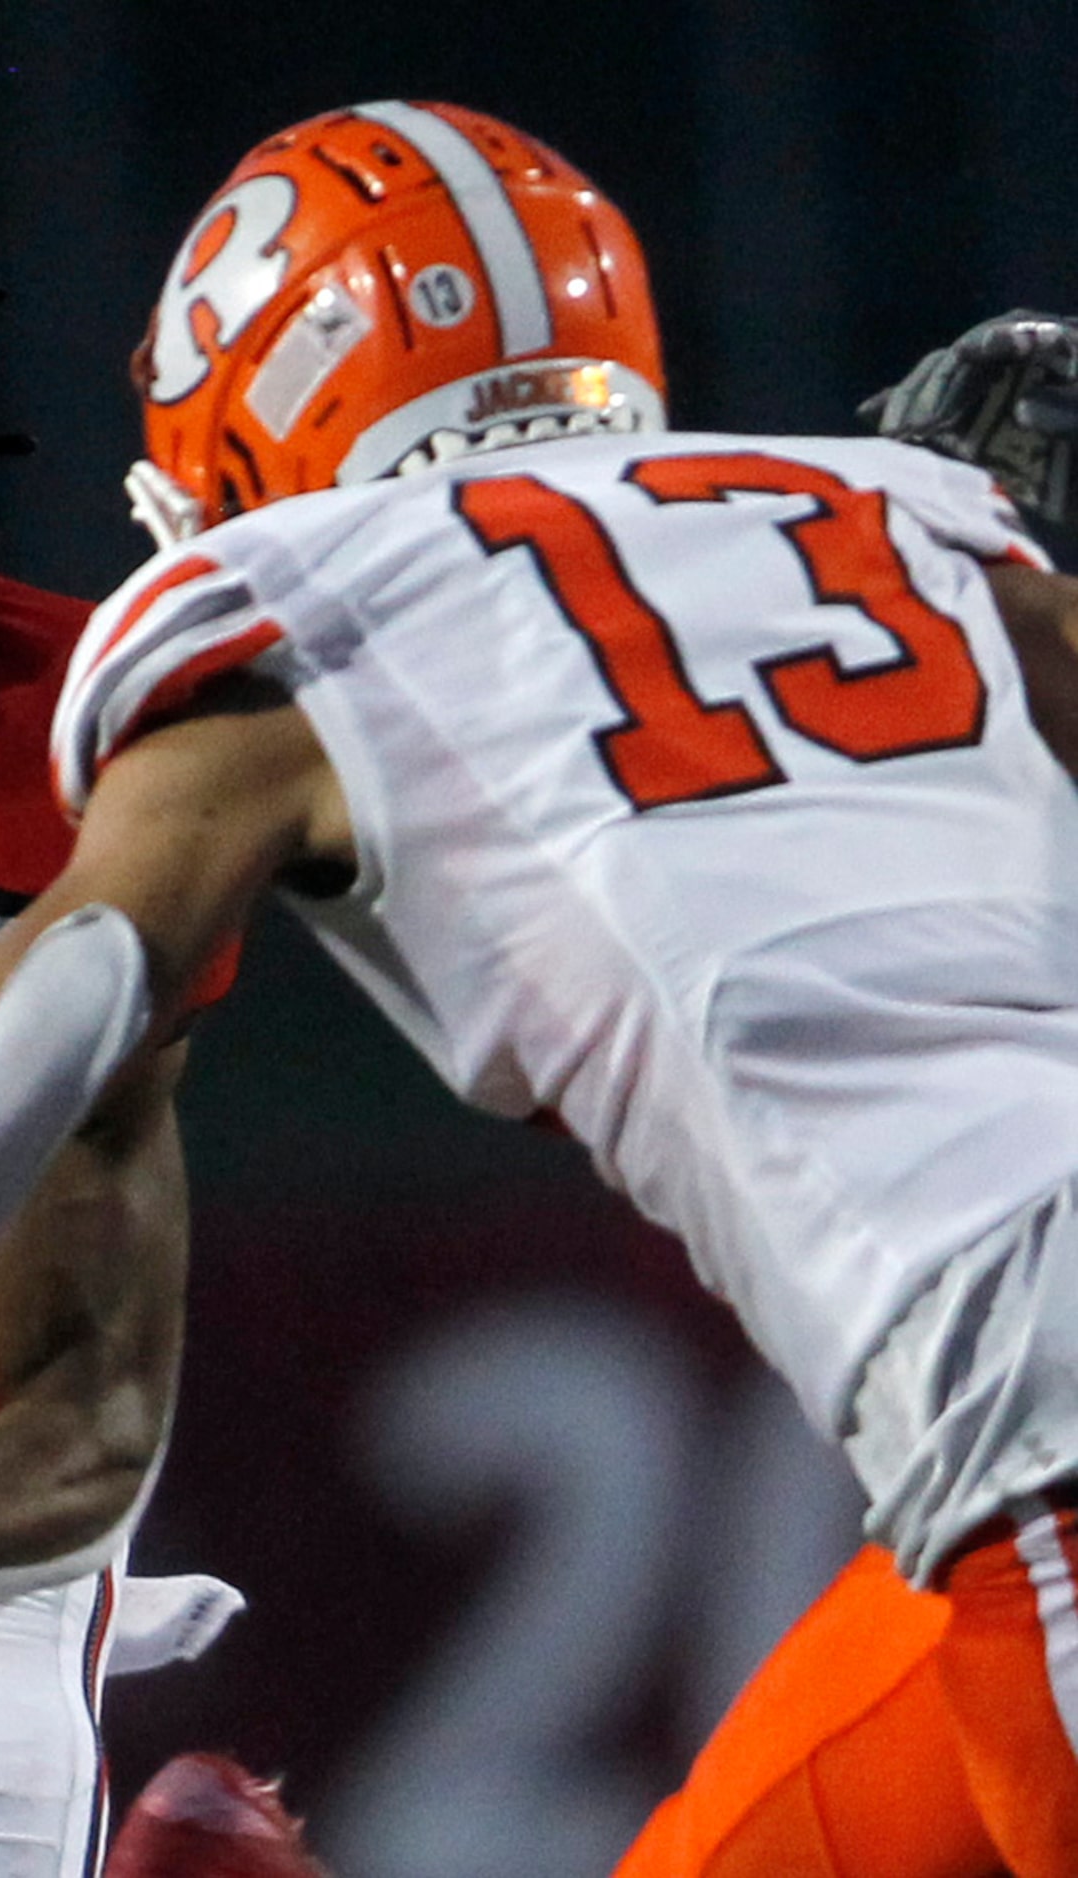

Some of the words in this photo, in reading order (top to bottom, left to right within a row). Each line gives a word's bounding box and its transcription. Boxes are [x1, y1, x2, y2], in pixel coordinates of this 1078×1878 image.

[150, 174, 298, 405] R
[418, 271, 463, 320] 13
[450, 450, 989, 814] 13
